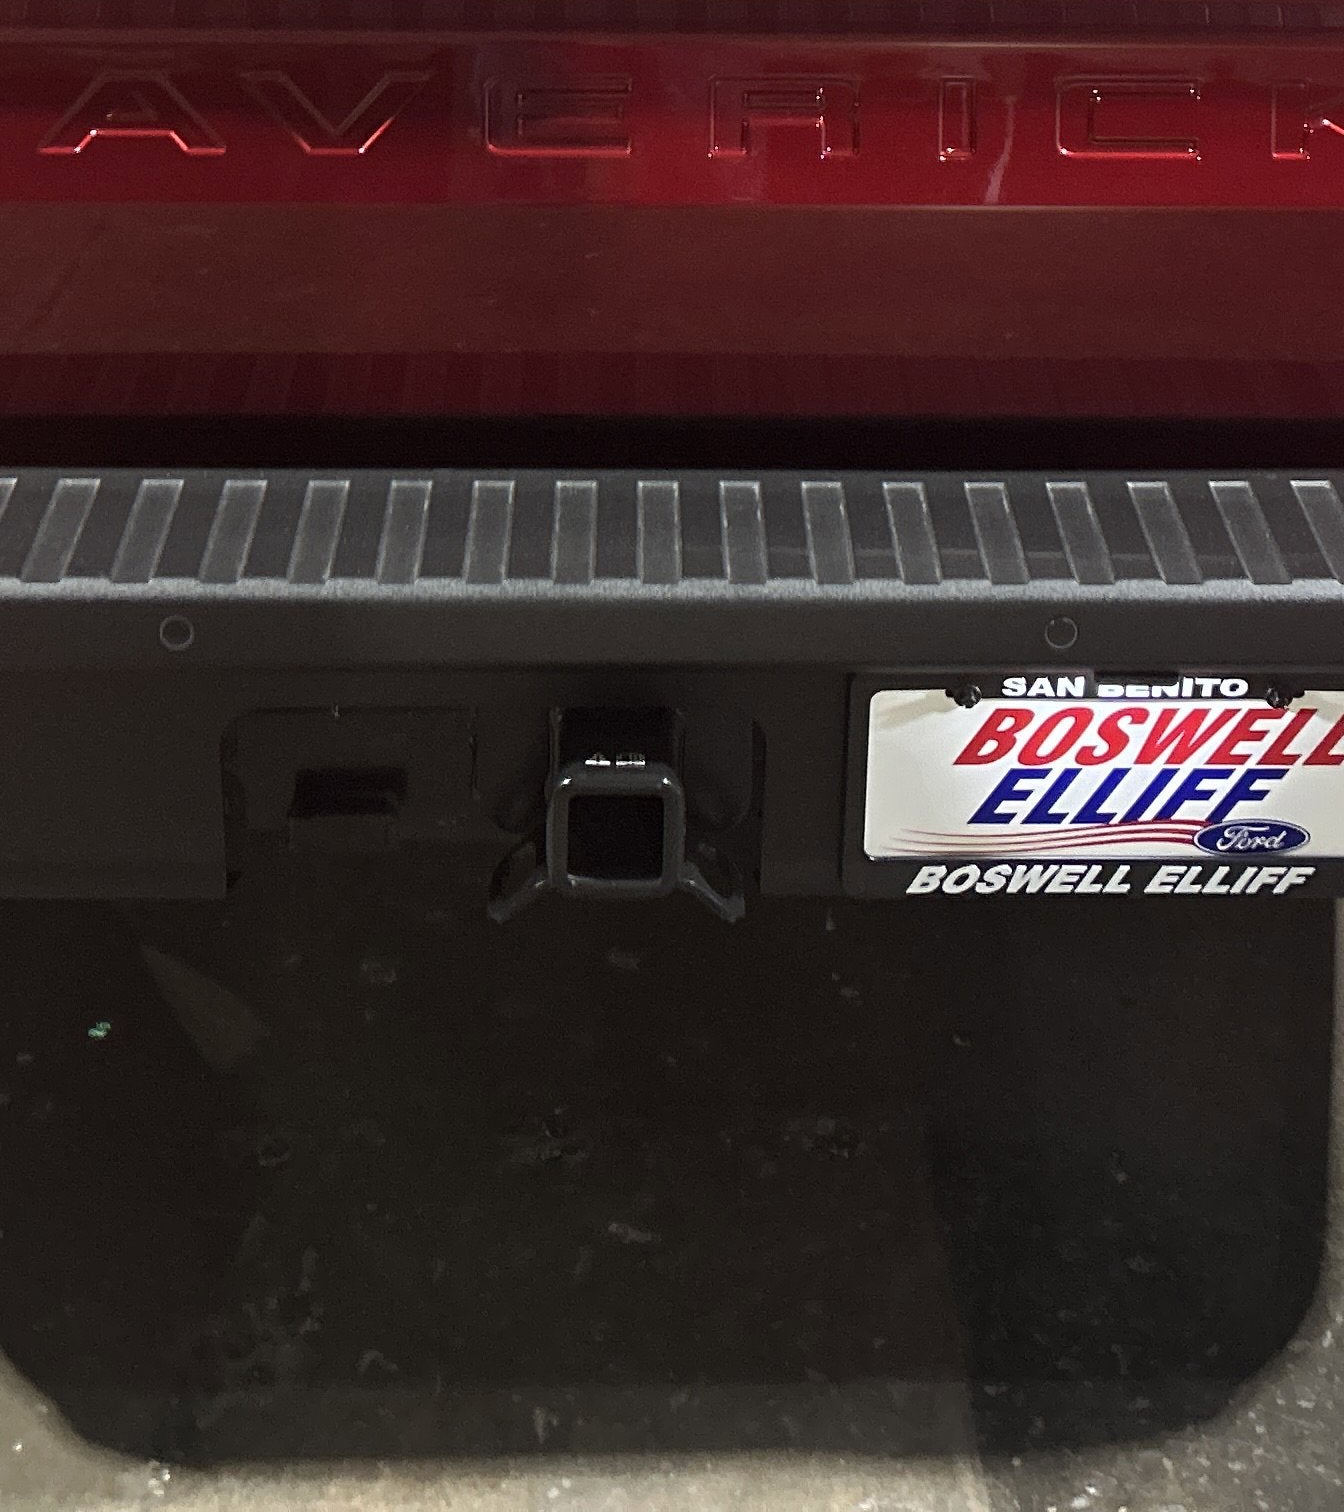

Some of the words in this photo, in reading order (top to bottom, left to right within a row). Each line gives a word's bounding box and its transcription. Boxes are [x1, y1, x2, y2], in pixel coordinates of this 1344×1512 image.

[1002, 676, 1086, 698] SAN
[967, 768, 1290, 825] ELLIFF
[1216, 825, 1288, 852] Ford
[905, 864, 1131, 895] BOSWELL
[1144, 865, 1316, 895] ELLIFF
